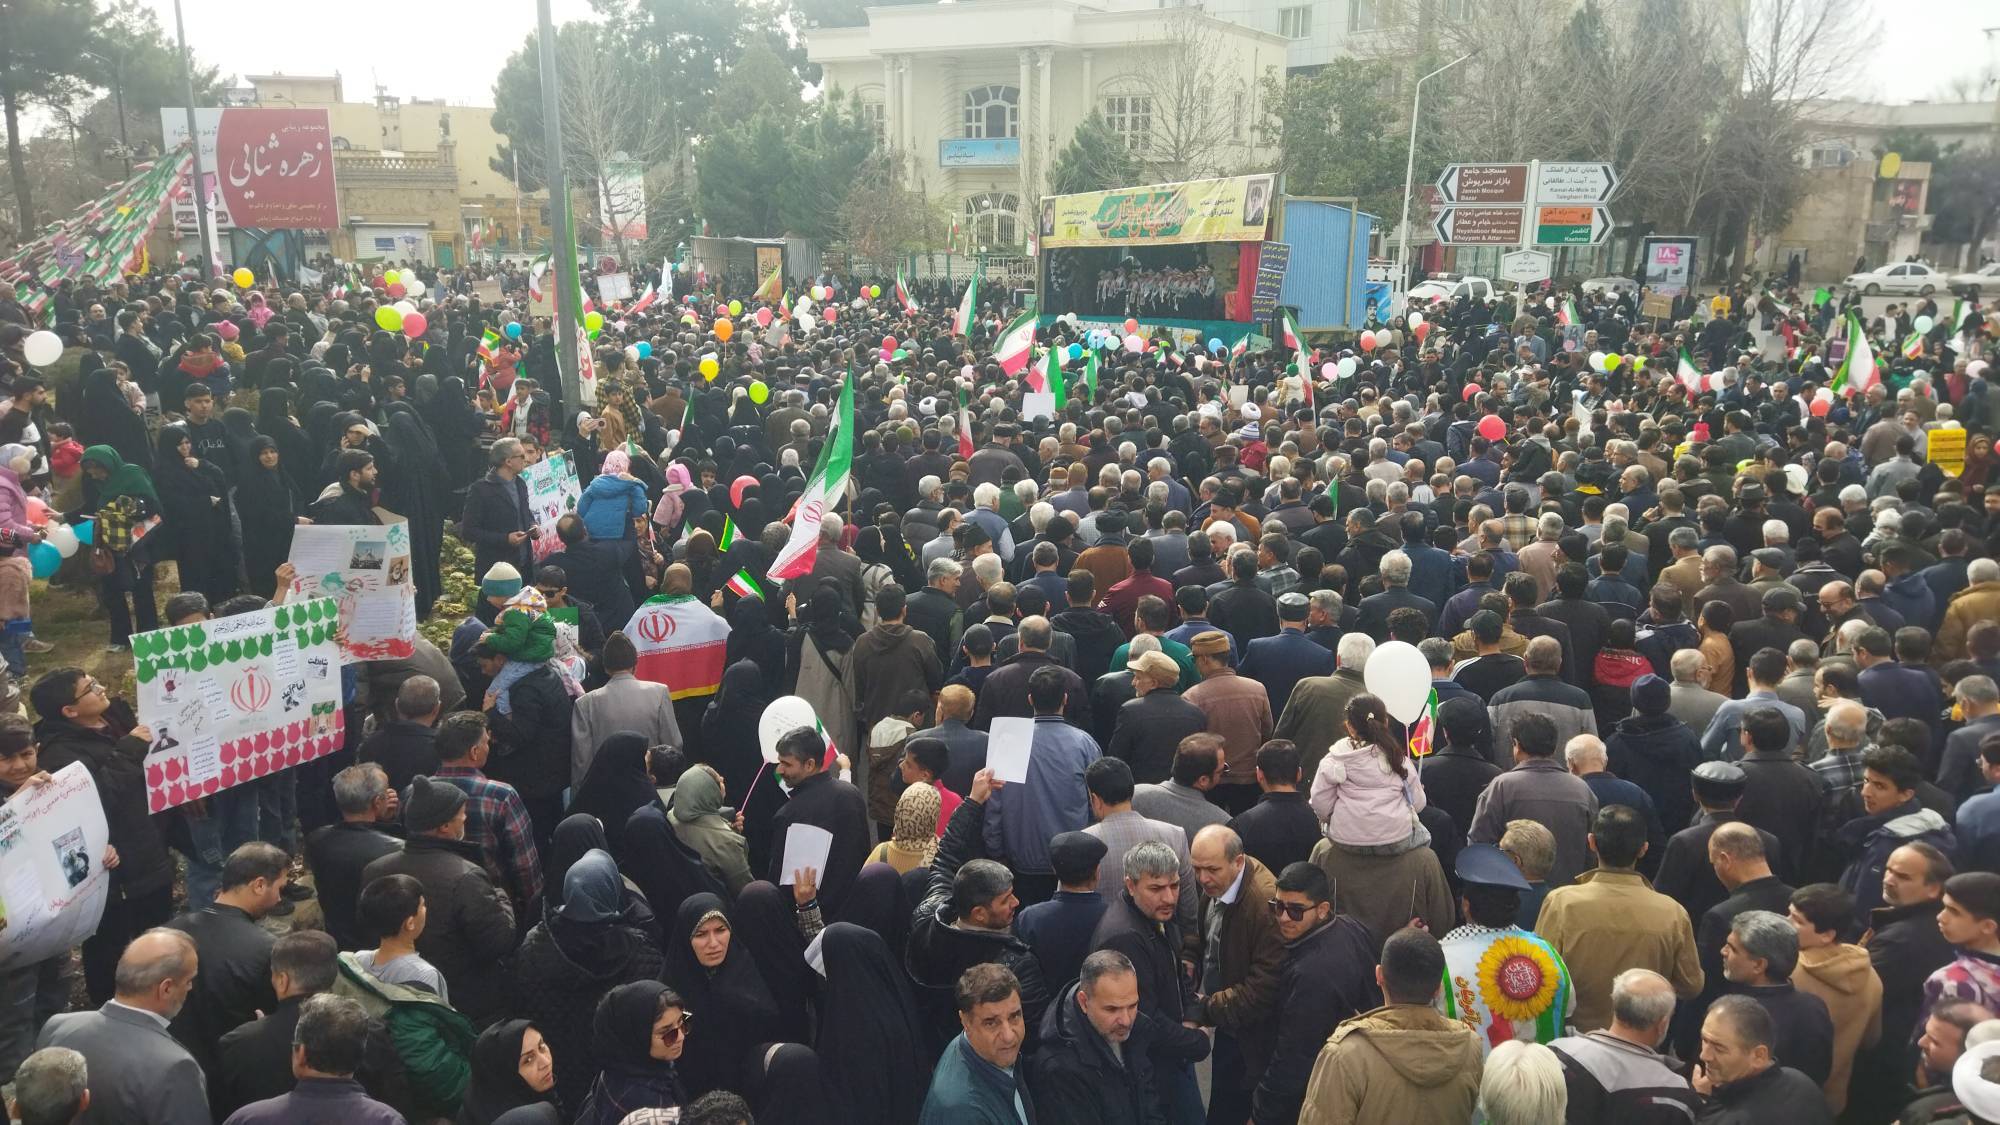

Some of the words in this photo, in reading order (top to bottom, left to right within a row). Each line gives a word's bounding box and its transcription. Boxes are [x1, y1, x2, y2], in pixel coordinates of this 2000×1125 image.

[279, 141, 324, 178] زهره
[229, 132, 279, 199] ثنایی
[1564, 166, 1580, 174] کمال
[1580, 166, 1598, 174] خیابان
[1462, 167, 1480, 177] جامع
[1493, 176, 1512, 186] بازار
[1542, 177, 1564, 185] طالقانی
[1456, 209, 1475, 218] (موزه)
[1455, 218, 1471, 226] عطار
[1477, 218, 1491, 227] خیام
[1570, 227, 1590, 235] کاشمر
[292, 679, 306, 692] امام
